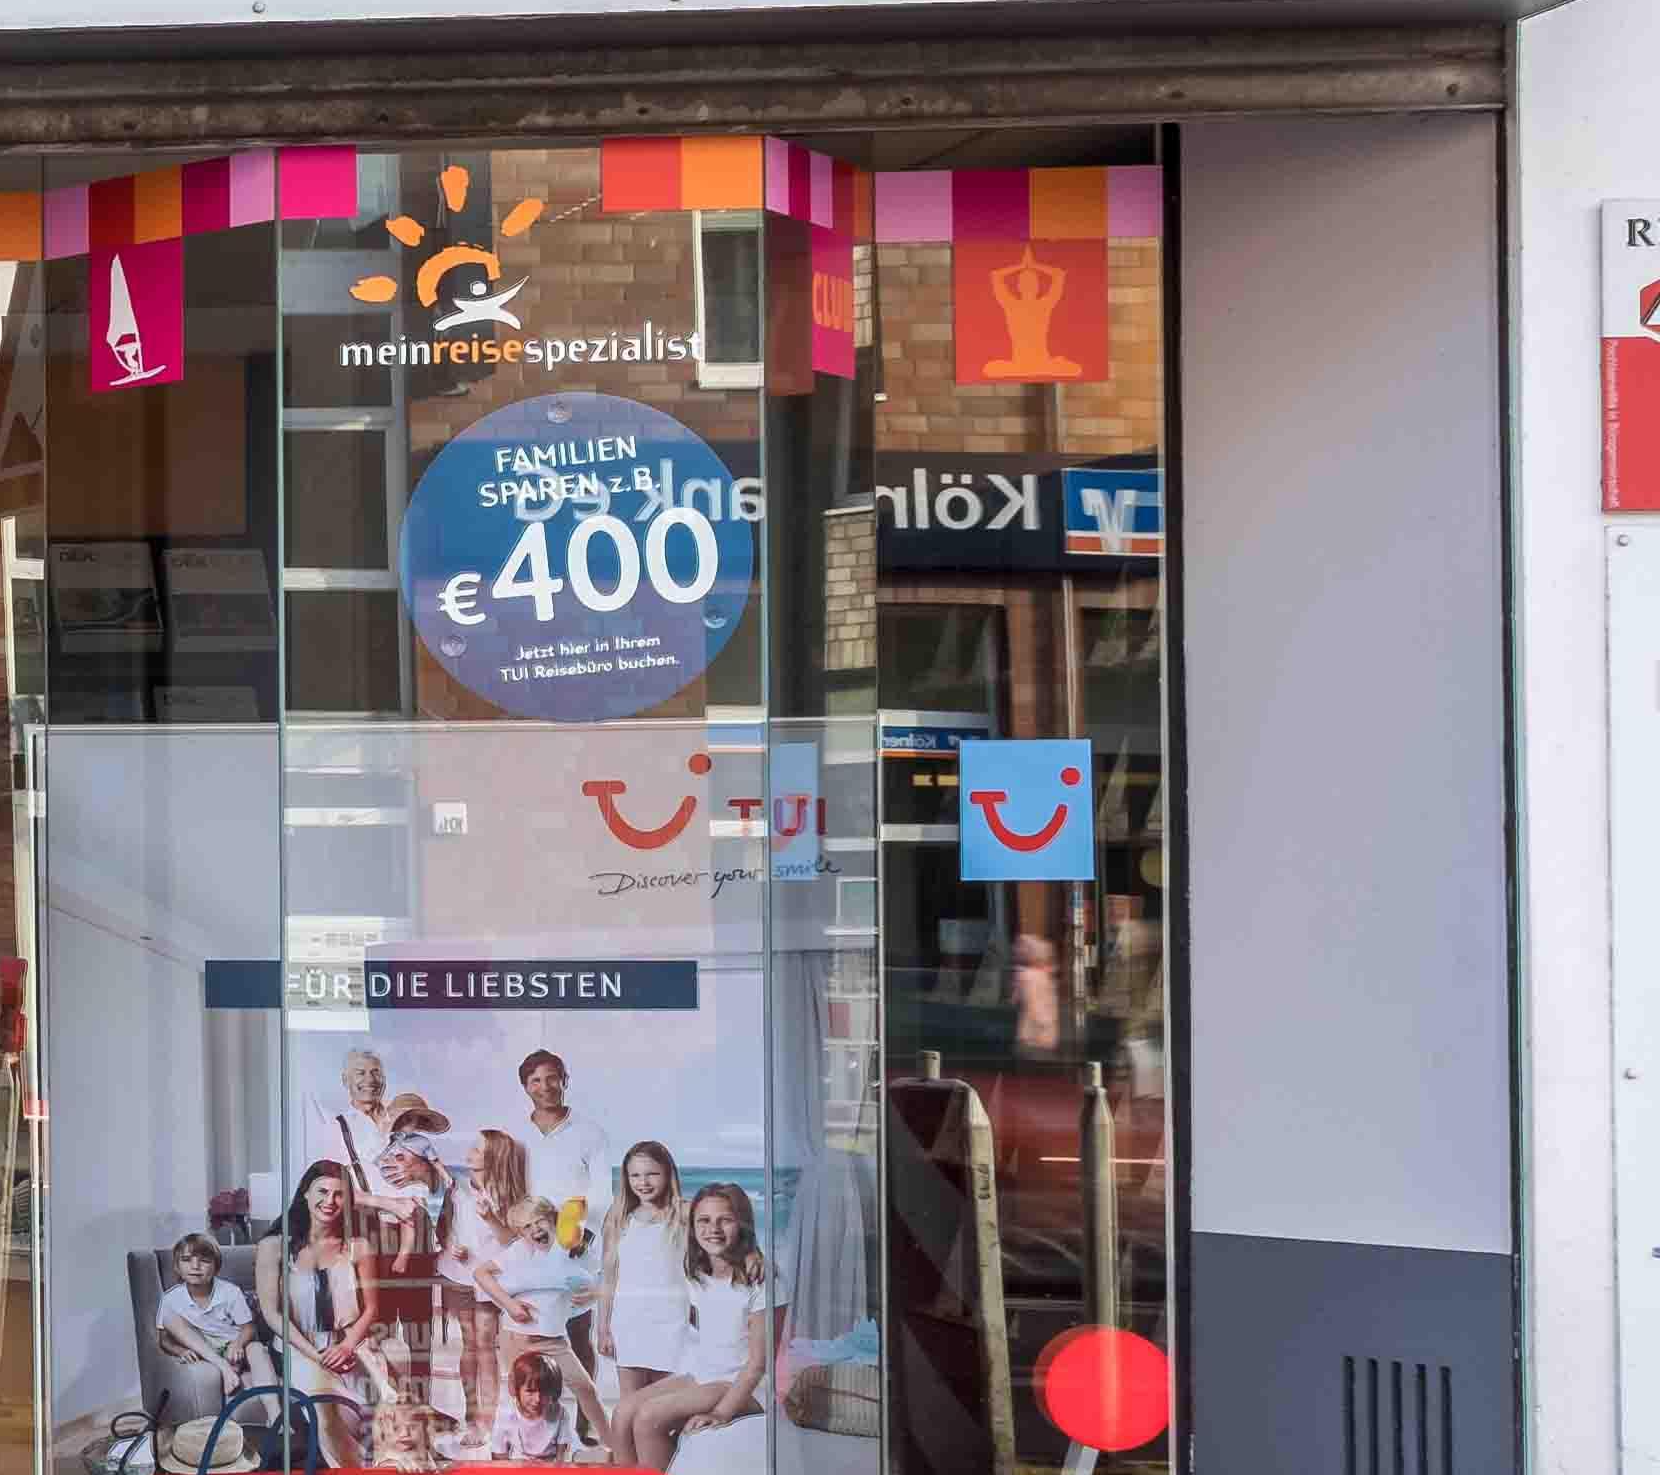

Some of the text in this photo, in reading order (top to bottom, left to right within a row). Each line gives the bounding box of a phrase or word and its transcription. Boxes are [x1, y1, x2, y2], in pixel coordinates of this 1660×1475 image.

[338, 320, 705, 372] meinreisespezialist
[493, 435, 638, 475] FAMILIEN
[477, 466, 663, 510] SPAREN z.B.
[515, 634, 662, 663] Jetzt hier in Ihrem
[499, 666, 531, 683] TUI
[533, 657, 614, 680] Reisebüro
[726, 796, 829, 837] TUI
[588, 853, 843, 899] Discover your smile
[368, 969, 431, 1001] DIE
[442, 969, 624, 1001] LIEBSTEN
